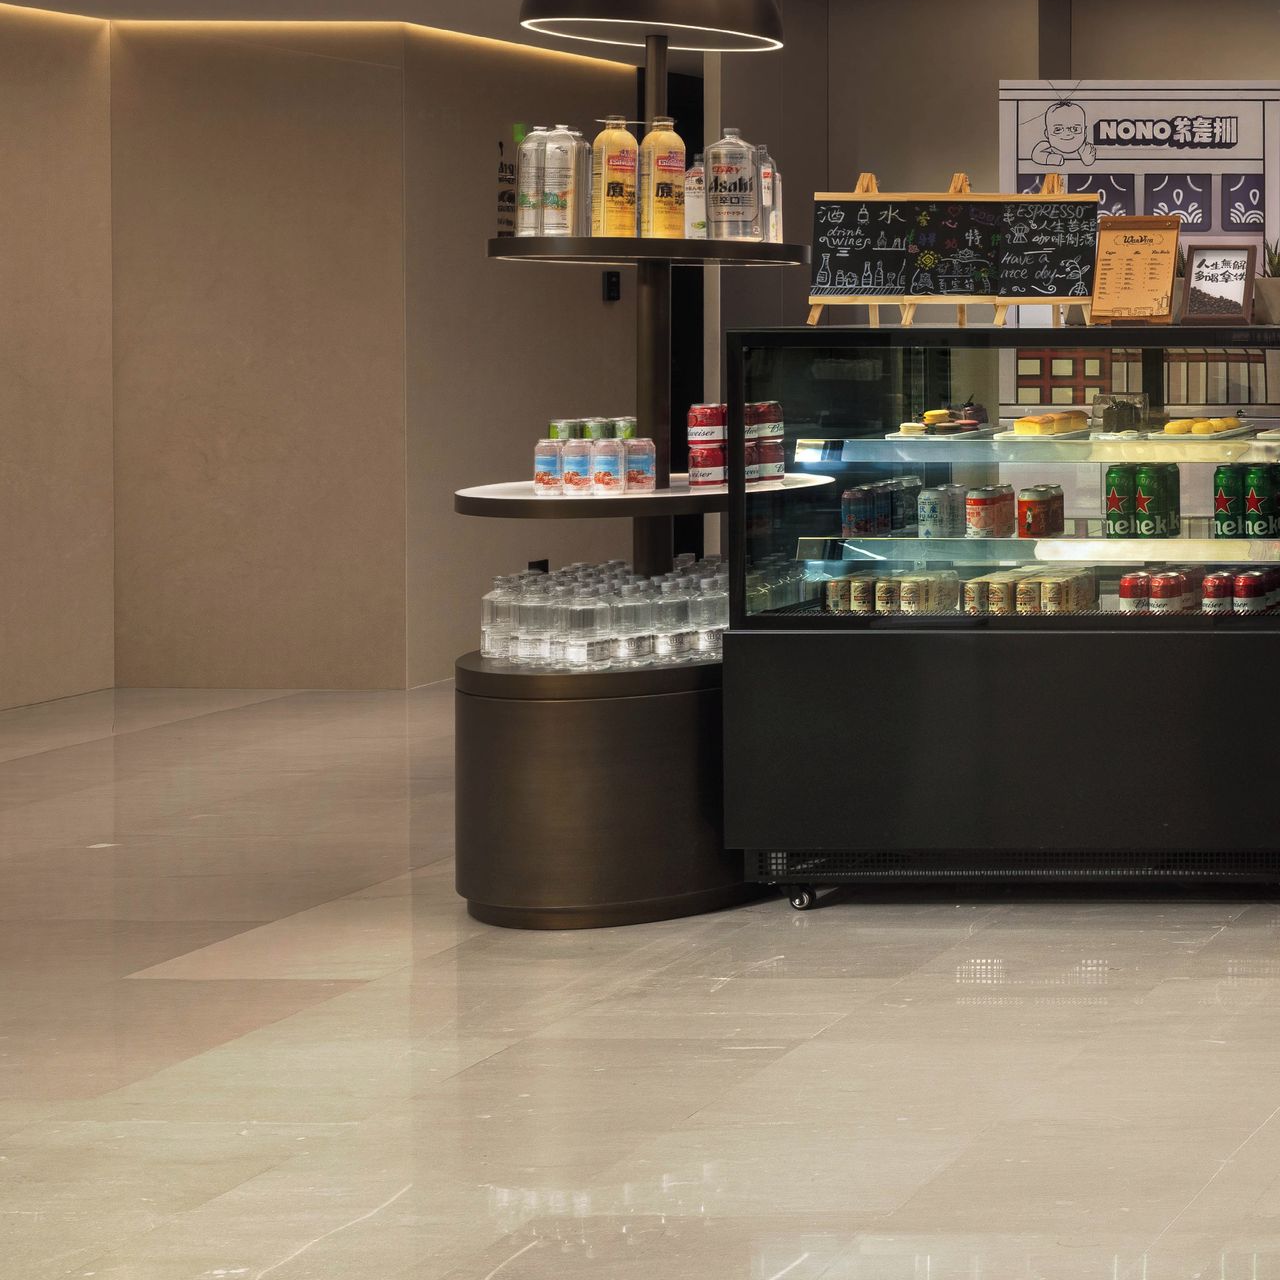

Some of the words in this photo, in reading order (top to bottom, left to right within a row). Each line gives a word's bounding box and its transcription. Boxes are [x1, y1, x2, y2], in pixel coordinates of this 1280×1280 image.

[708, 176, 753, 193] Asahi
[1016, 204, 1084, 221] ESPRESSO
[827, 226, 865, 237] drink
